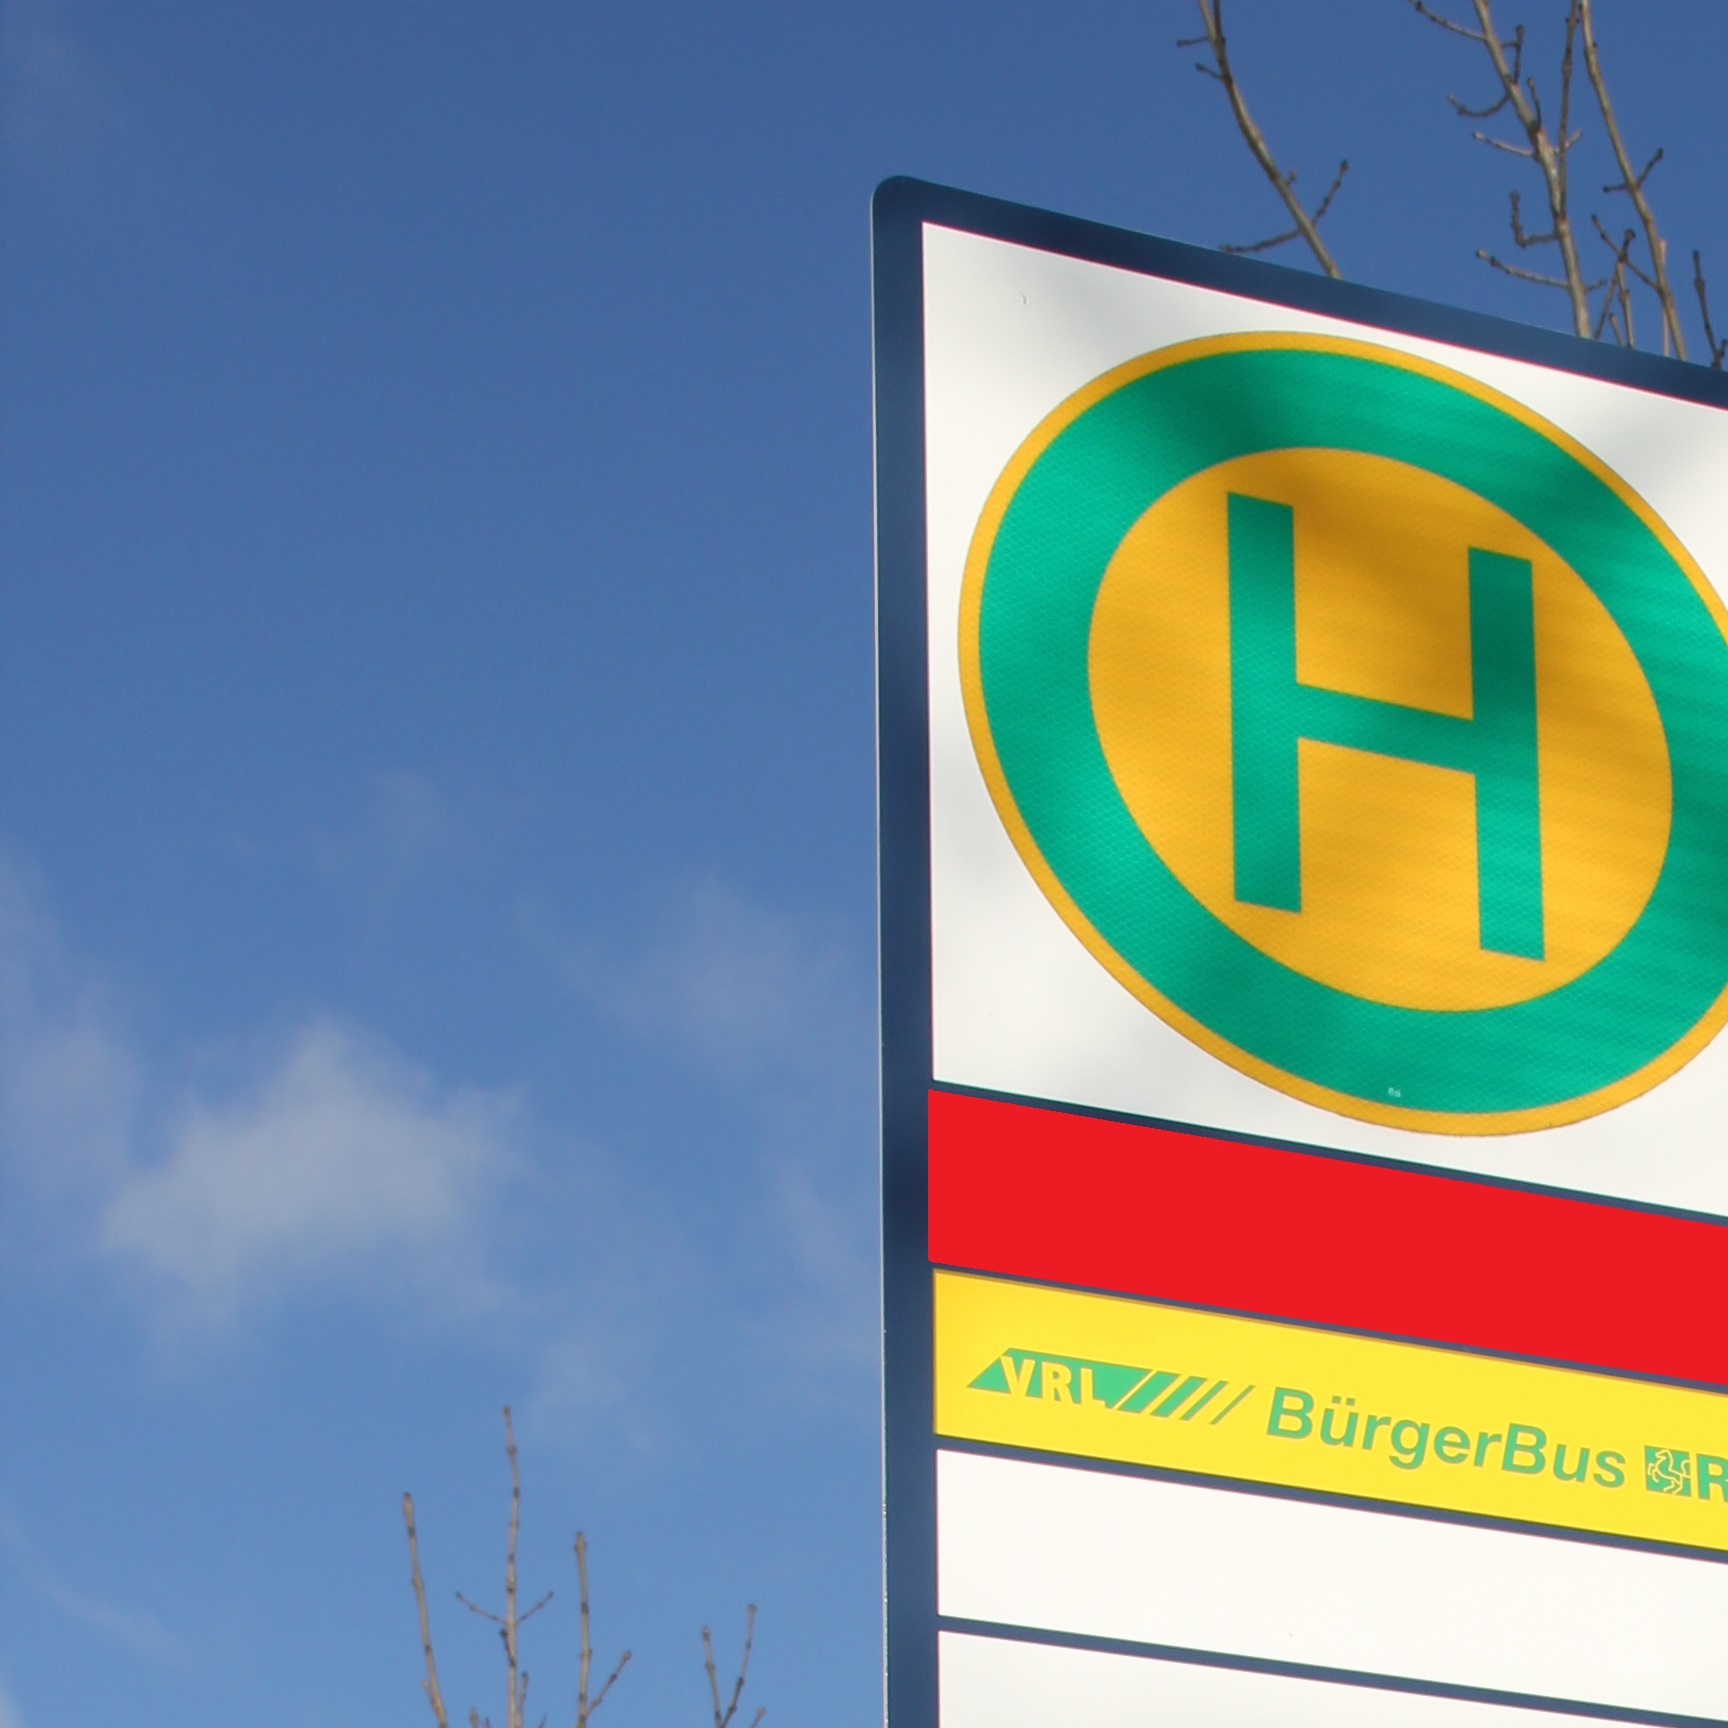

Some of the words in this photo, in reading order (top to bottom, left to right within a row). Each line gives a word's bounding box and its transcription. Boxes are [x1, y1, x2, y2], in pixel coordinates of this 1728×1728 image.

[1226, 492, 1546, 960] H
[998, 1353, 1115, 1409] VRL
[1267, 1386, 1627, 1488] BürgerBus
